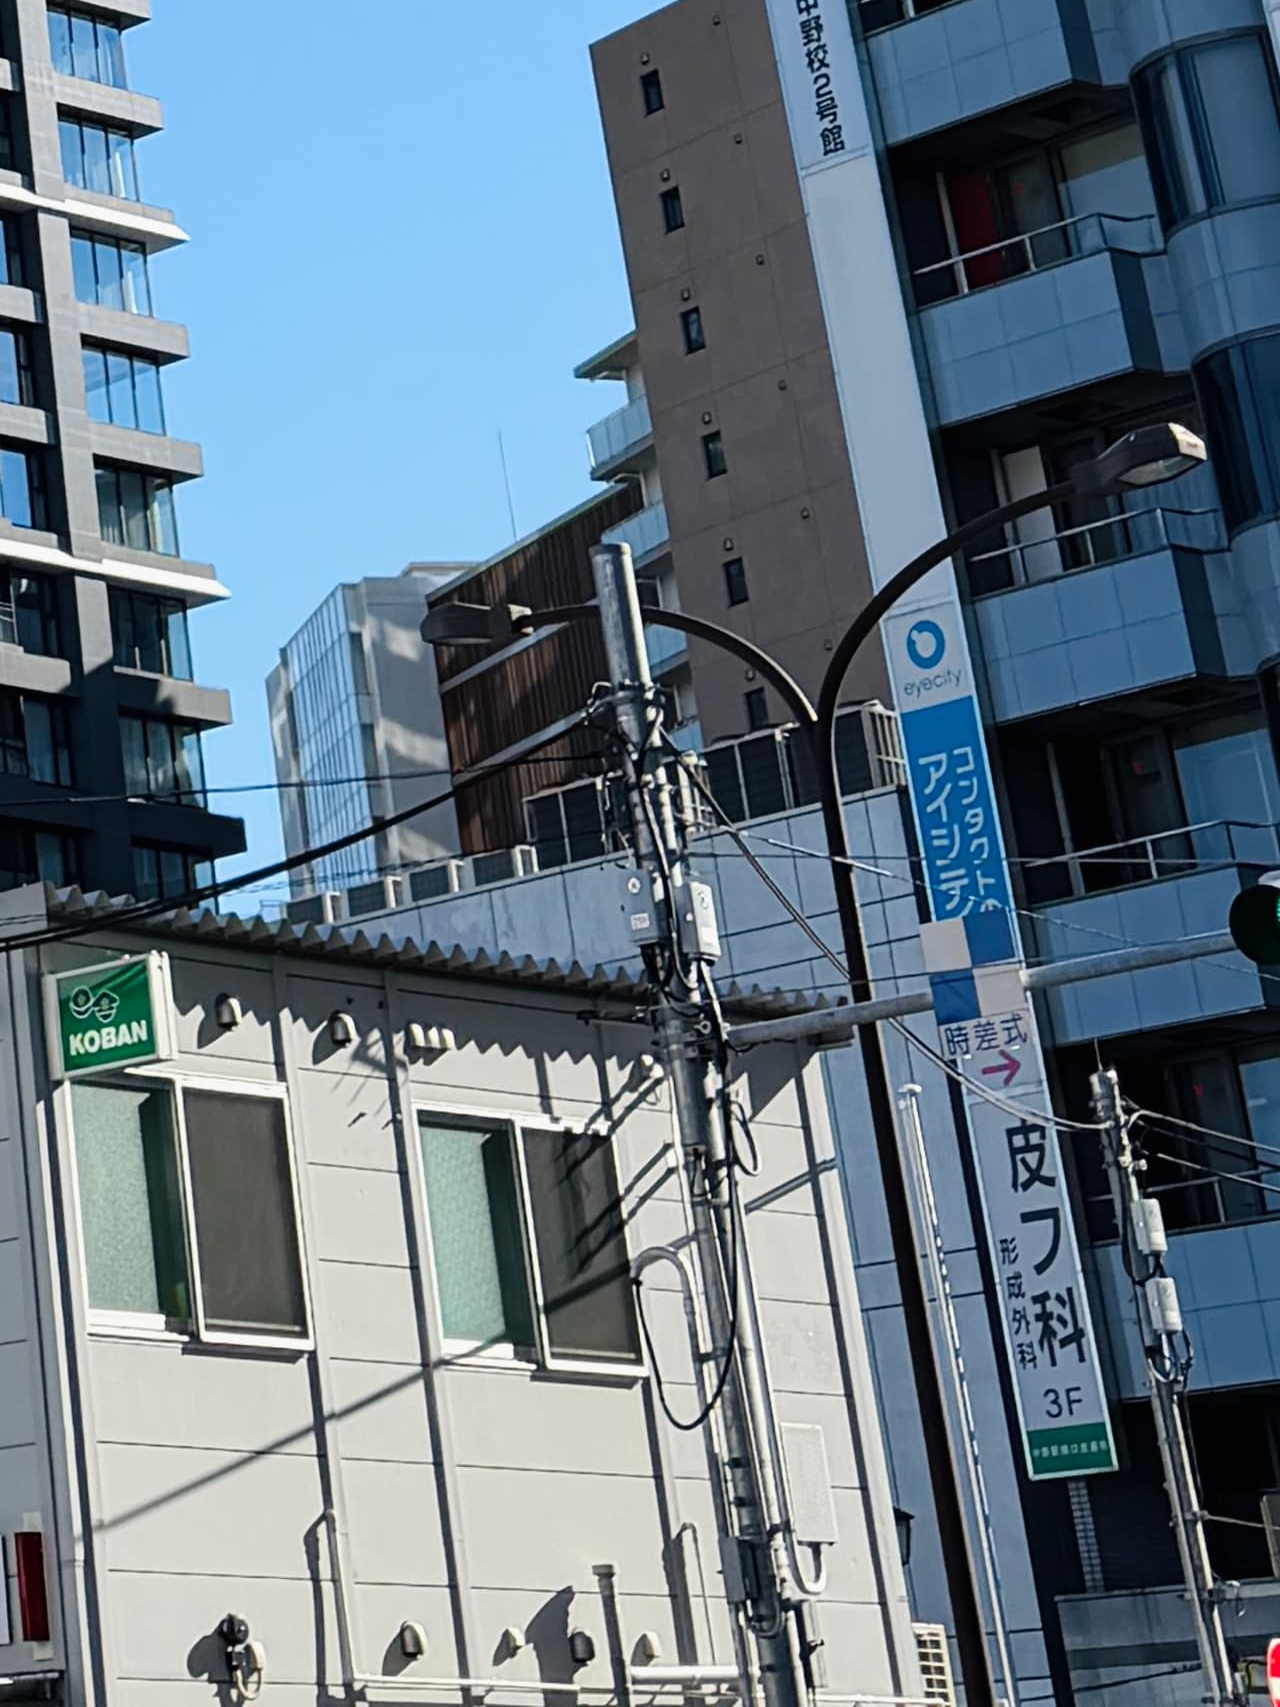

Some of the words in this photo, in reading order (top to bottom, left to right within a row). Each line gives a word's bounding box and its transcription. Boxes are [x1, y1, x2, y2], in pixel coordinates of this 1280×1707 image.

[903, 669, 962, 699] eyecity
[69, 1020, 148, 1056] KOBAN
[945, 1013, 1028, 1056] 時差式
[1005, 1120, 1086, 1367] 皮フ科
[1000, 1237, 1038, 1369] 形成外科
[1044, 1387, 1083, 1418] 3F
